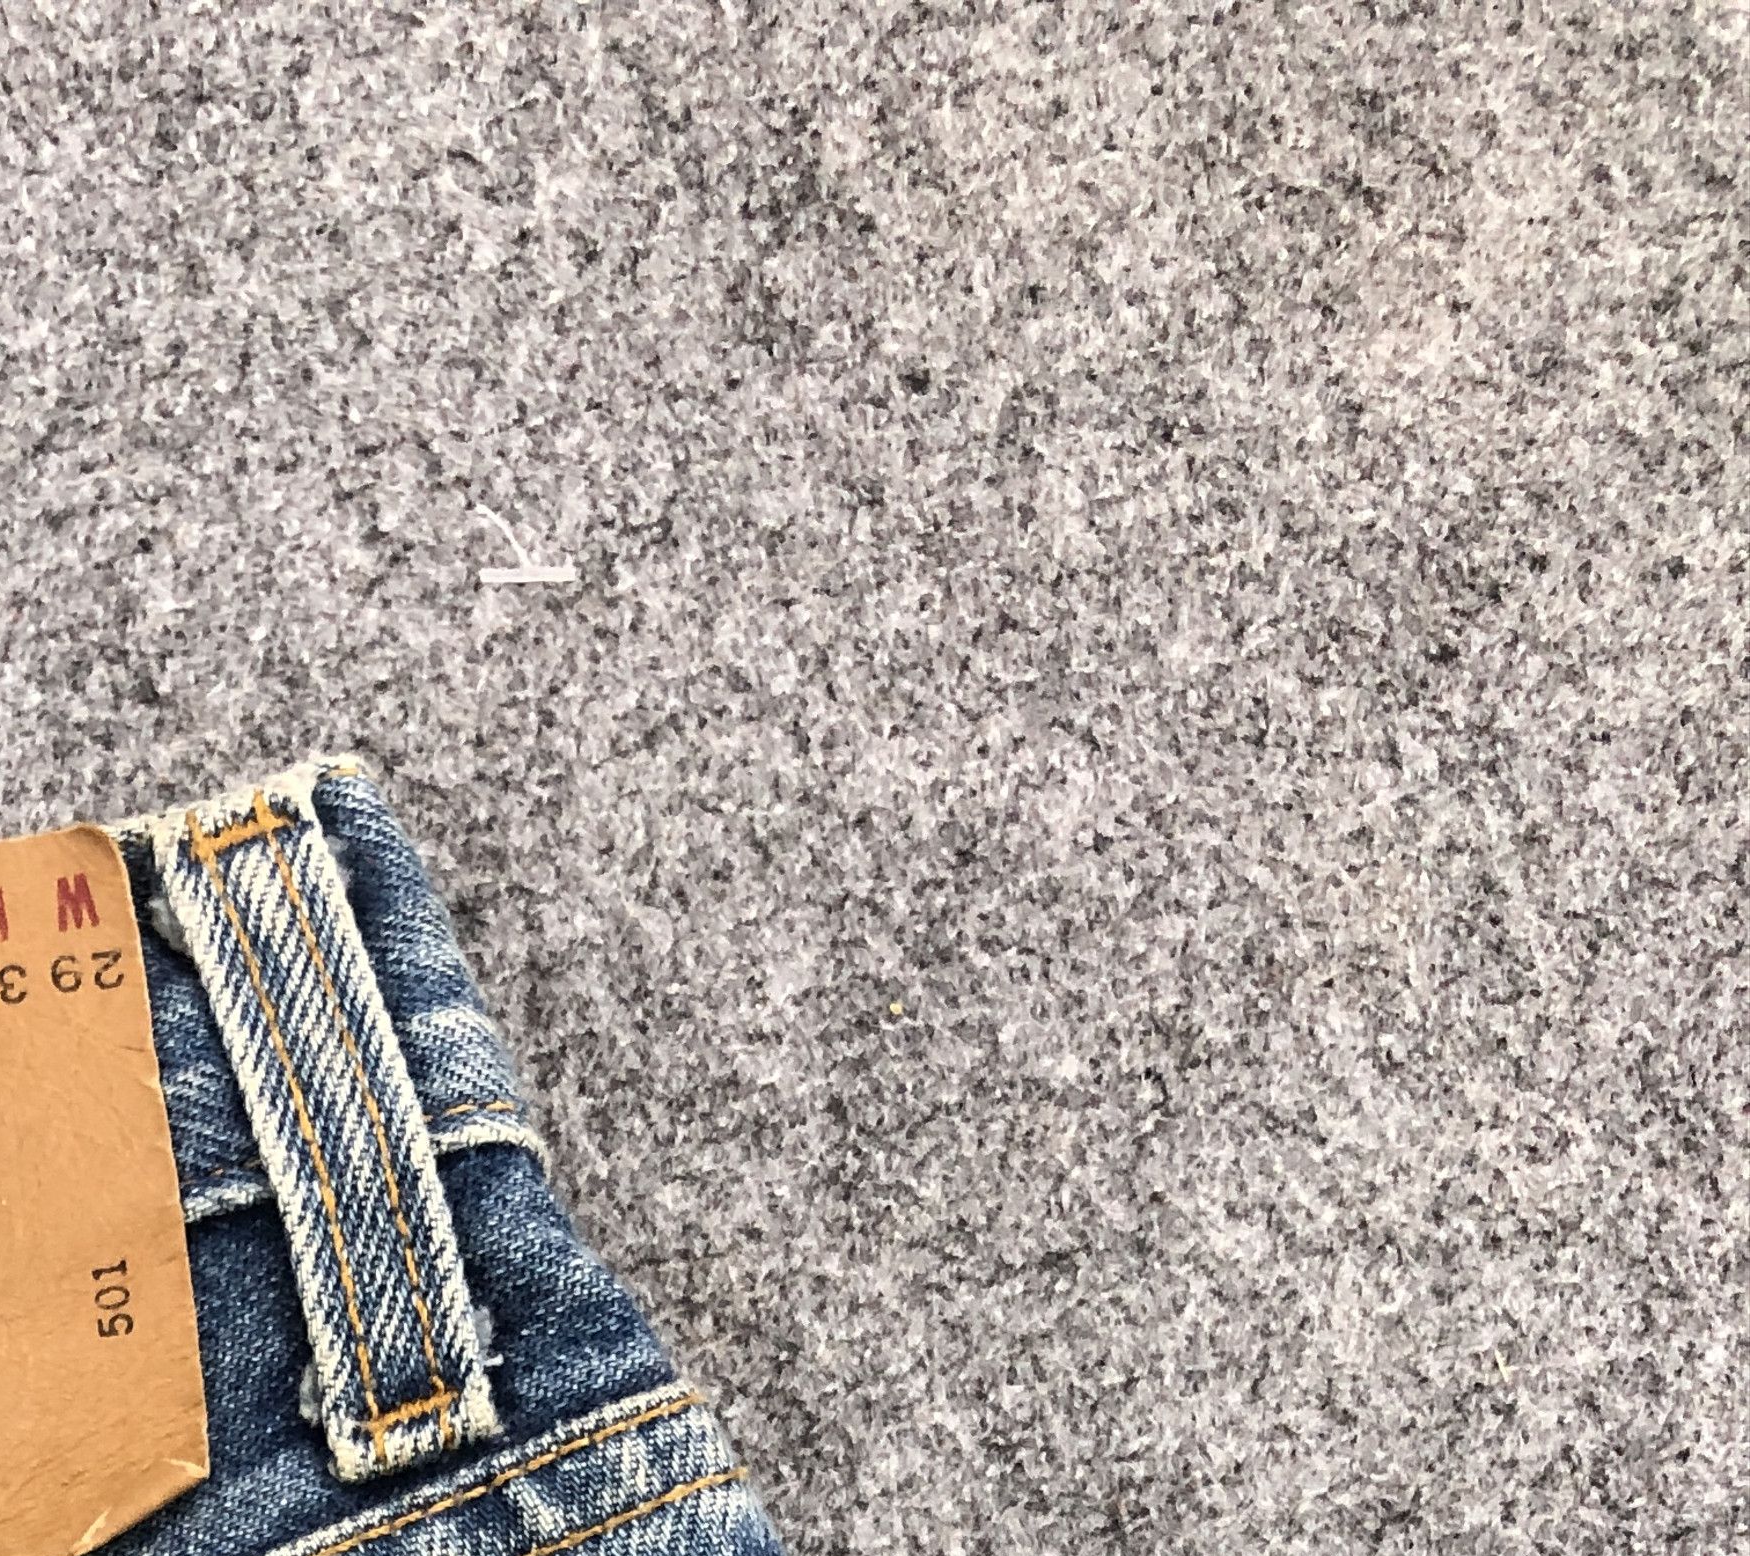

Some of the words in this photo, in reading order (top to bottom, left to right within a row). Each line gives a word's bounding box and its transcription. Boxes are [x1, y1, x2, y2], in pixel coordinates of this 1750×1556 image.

[57, 872, 99, 932] W
[51, 949, 124, 993] 29
[92, 1258, 134, 1338] 501
